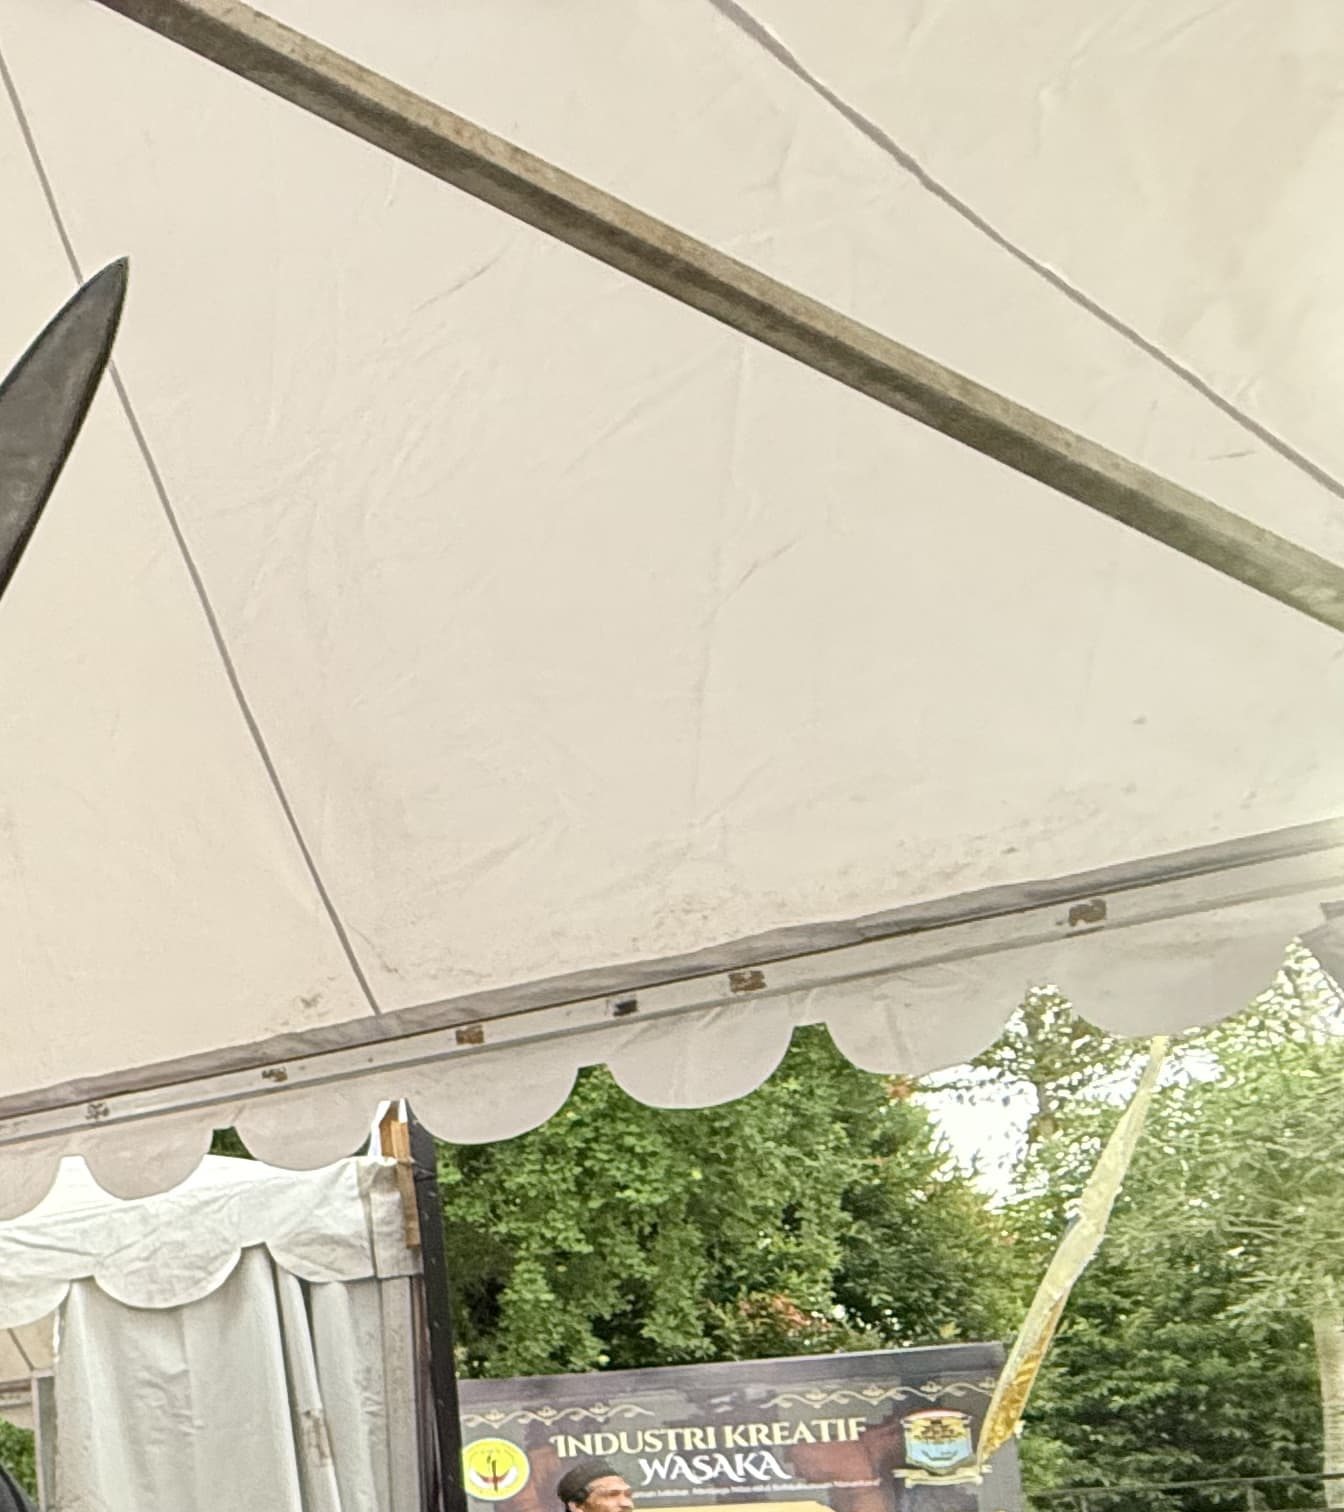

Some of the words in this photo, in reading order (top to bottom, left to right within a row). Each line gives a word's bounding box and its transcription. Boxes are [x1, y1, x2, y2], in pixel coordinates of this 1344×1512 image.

[549, 1425, 716, 1458] INDUSTRI
[724, 1417, 867, 1449] KREATIF
[639, 1451, 792, 1486] WASAKA
